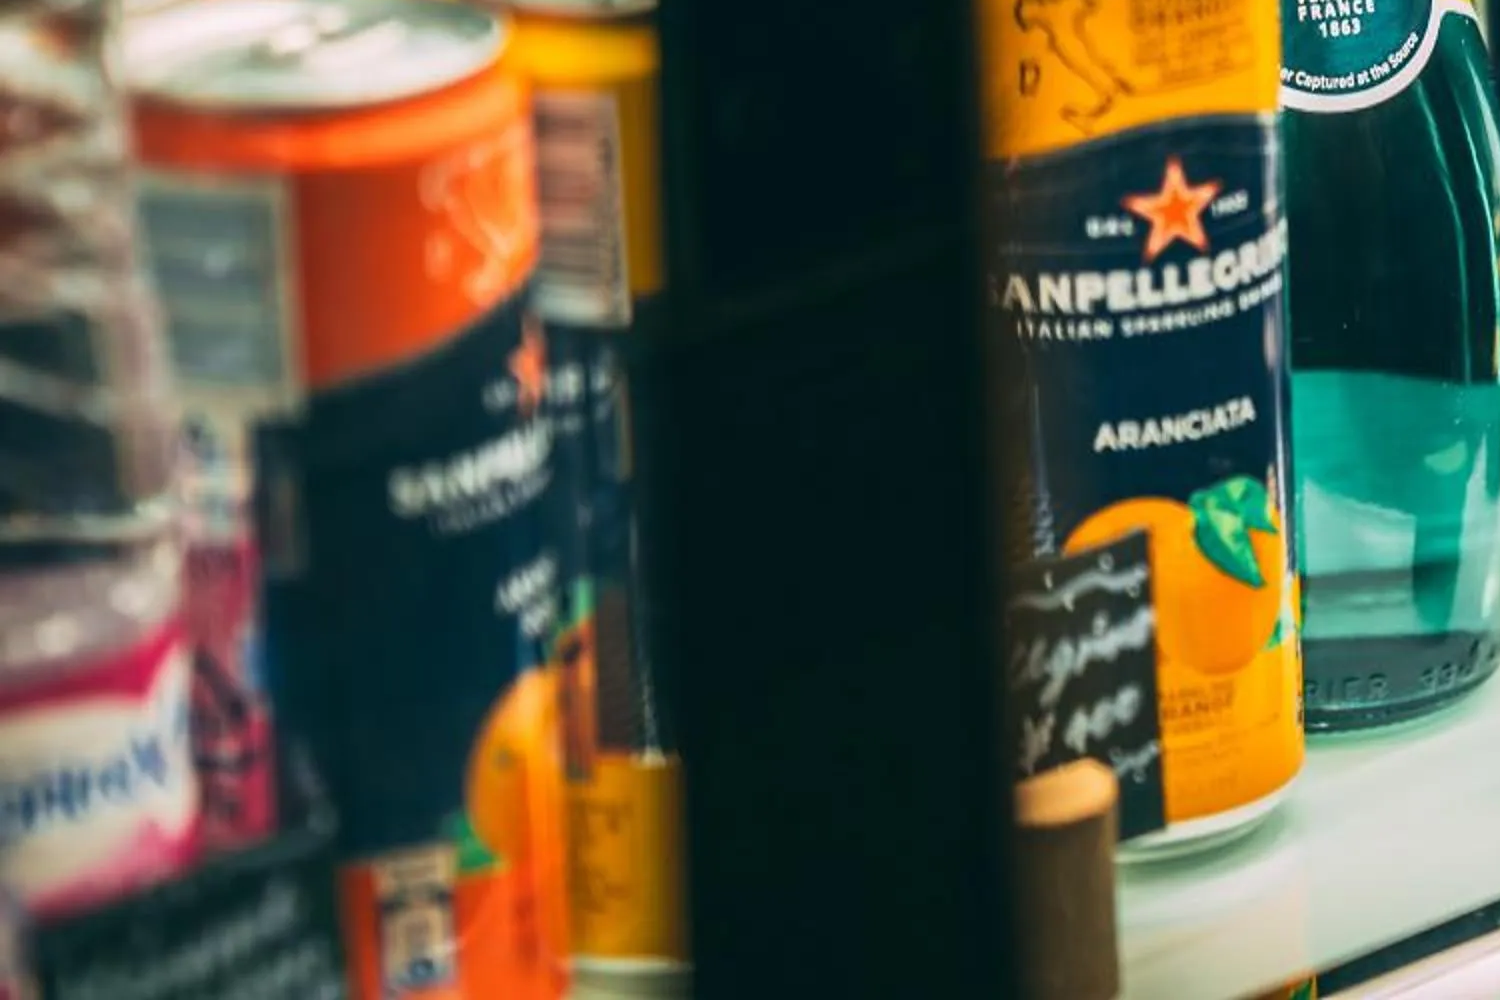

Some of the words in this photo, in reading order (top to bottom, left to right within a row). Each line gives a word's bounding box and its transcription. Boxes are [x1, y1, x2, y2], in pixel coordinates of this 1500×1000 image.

[1319, 18, 1361, 38] 1863
[1295, 71, 1355, 92] Captured
[1356, 70, 1371, 84] at
[1369, 61, 1391, 80] the
[1387, 31, 1419, 69] Source
[1093, 395, 1257, 453] ARANCIATA
